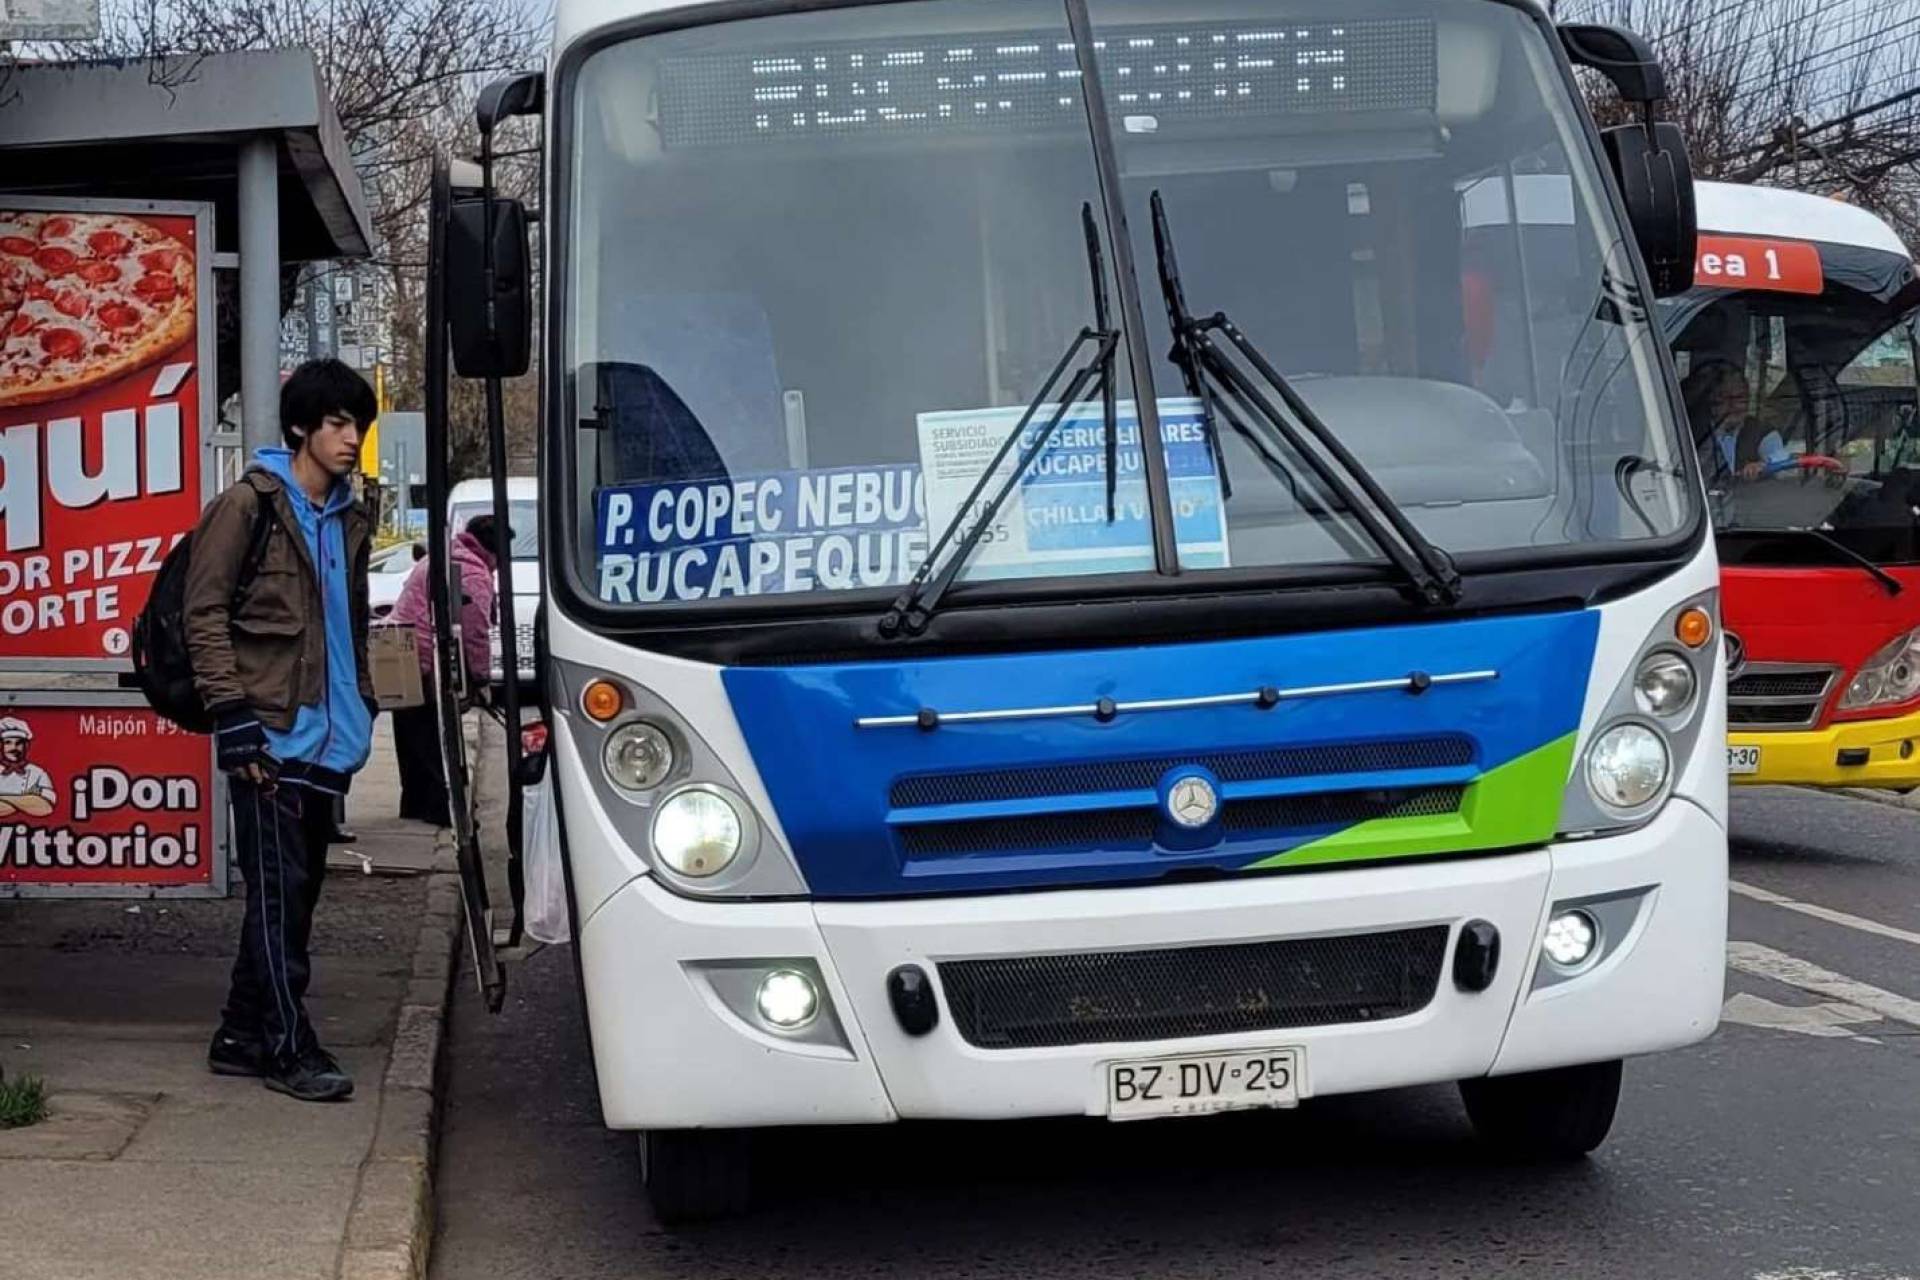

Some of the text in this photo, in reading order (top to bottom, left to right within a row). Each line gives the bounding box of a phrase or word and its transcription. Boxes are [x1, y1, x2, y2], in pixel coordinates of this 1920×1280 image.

[1695, 248, 1780, 279] ea 1
[932, 424, 987, 438] SERVICIO
[605, 493, 634, 546] P.
[649, 478, 783, 542] COPEC
[2, 585, 119, 634] ORTE
[79, 714, 146, 739] Maipón
[74, 768, 197, 819] ¡Don
